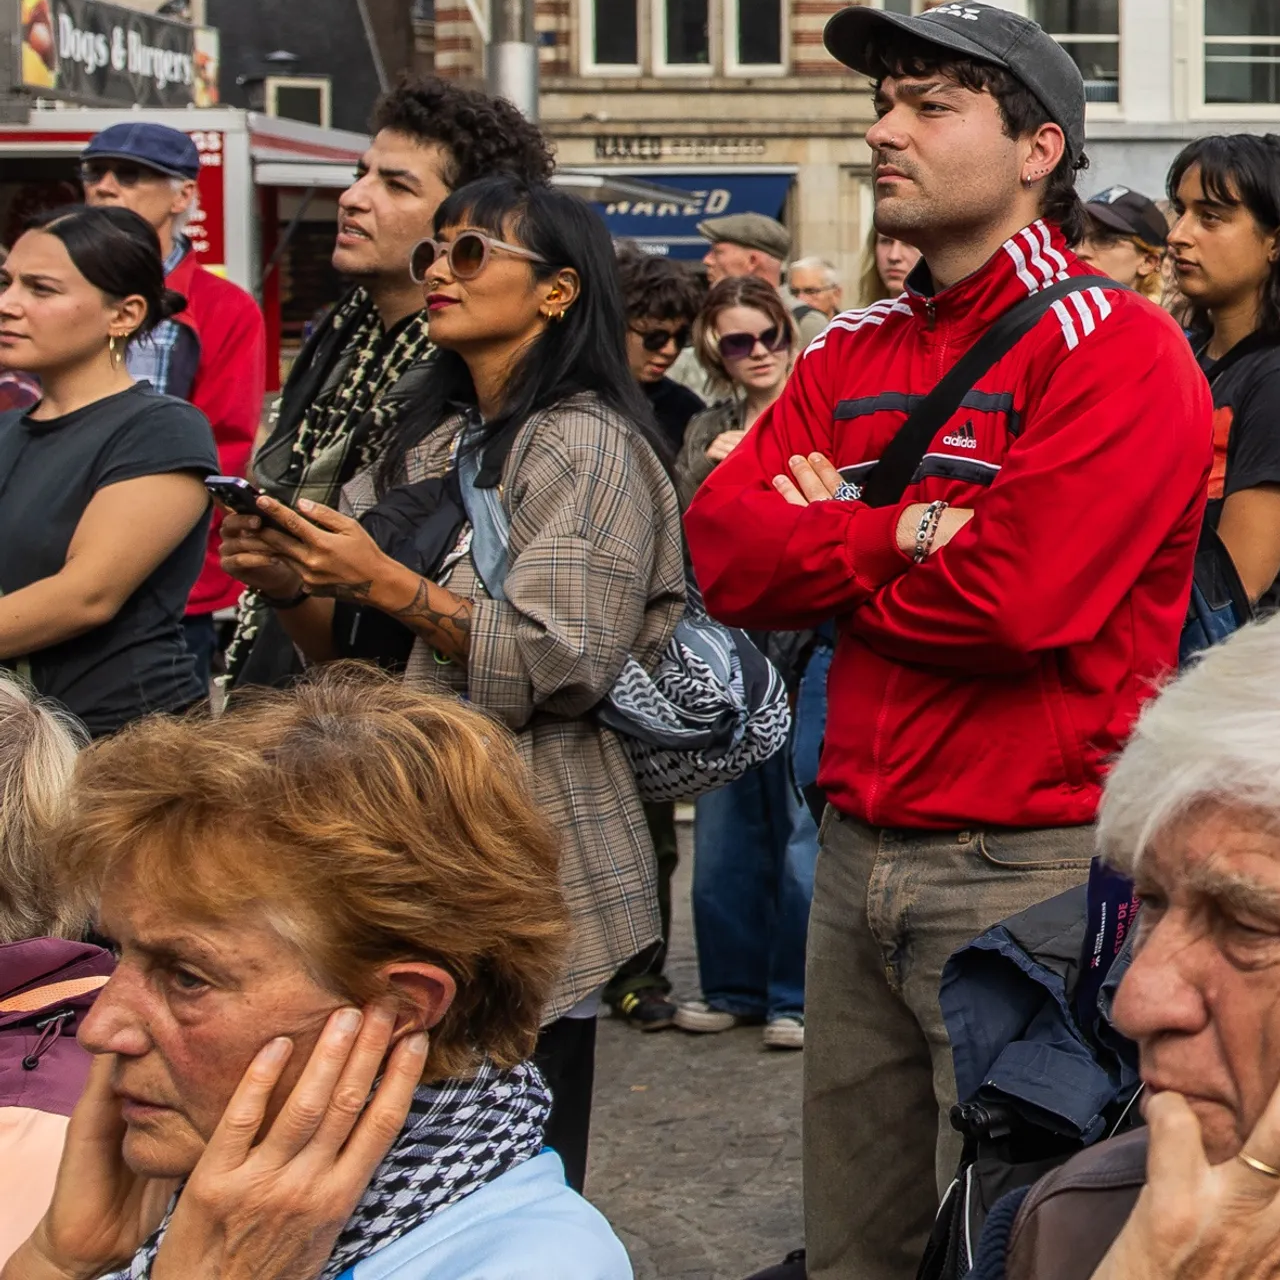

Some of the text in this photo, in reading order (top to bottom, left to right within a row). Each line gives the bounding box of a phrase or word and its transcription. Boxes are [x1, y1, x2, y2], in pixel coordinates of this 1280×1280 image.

[58, 12, 193, 90] Dogs & Burgers
[943, 436, 976, 448] adidas
